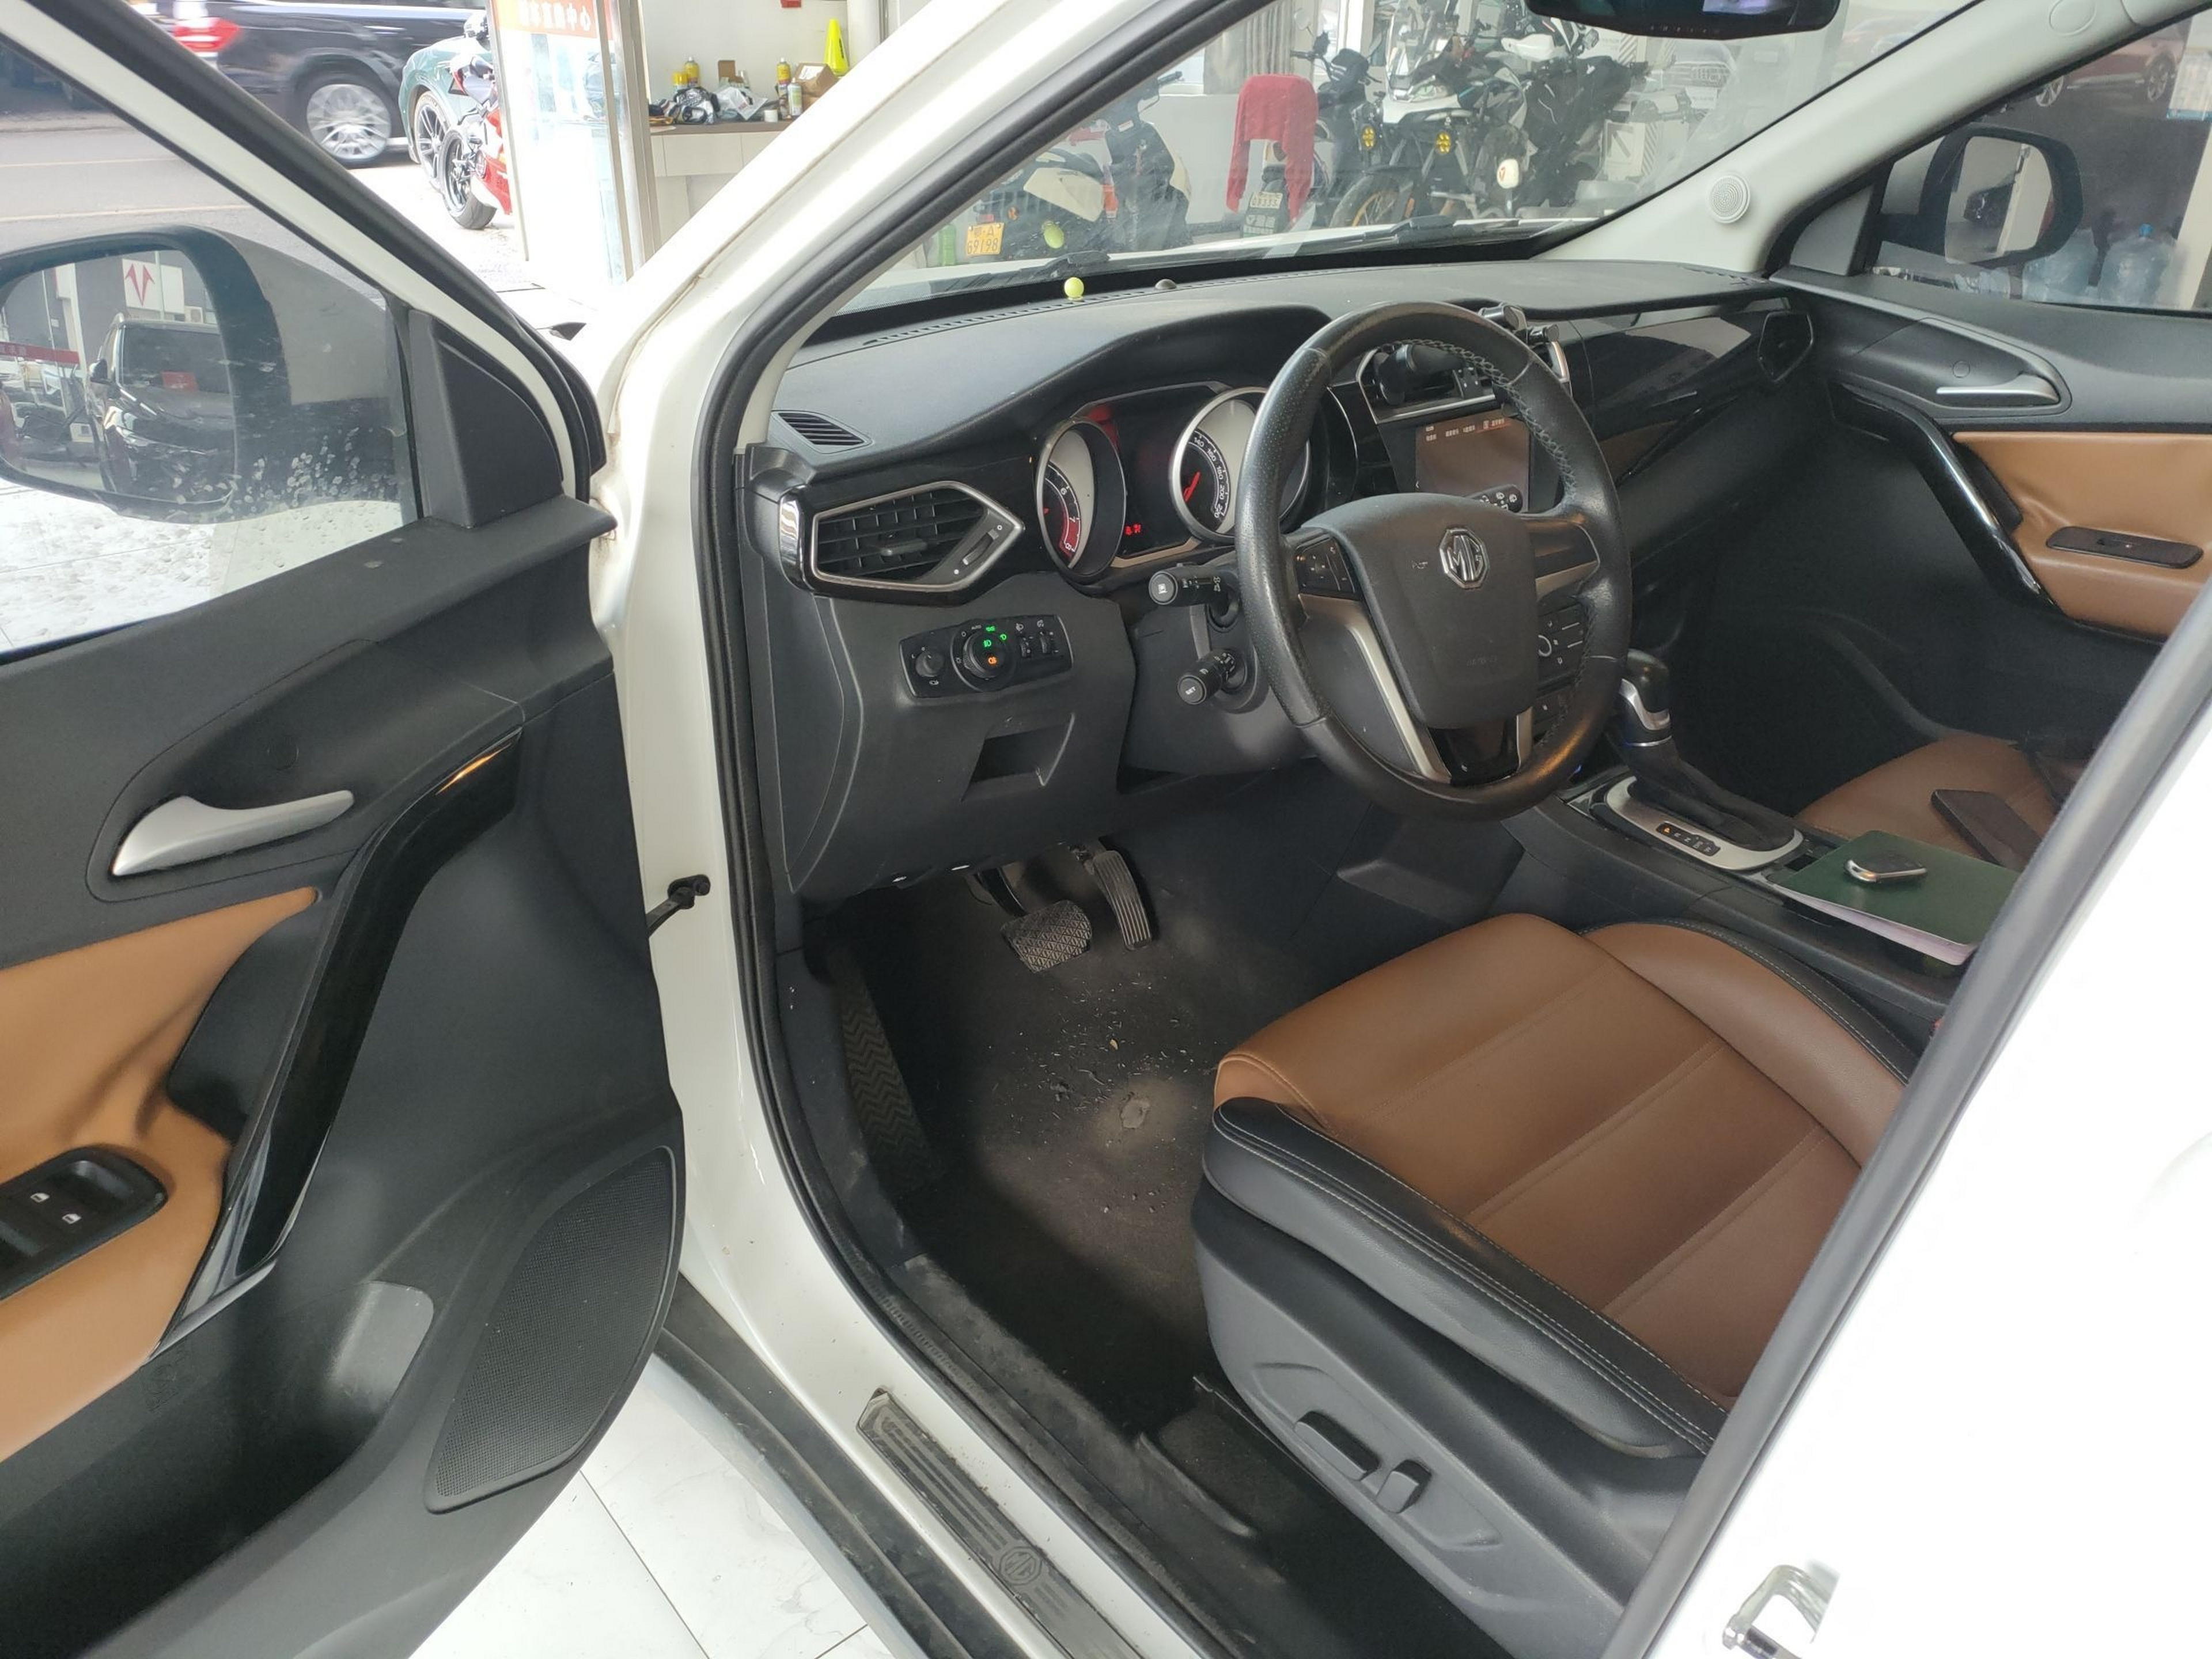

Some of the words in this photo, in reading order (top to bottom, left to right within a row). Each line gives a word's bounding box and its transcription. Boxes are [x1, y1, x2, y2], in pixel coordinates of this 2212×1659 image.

[1194, 437, 1205, 448] 140
[1207, 448, 1216, 462] 160
[1060, 487, 1067, 495] 6
[1065, 543, 1072, 551] 8
